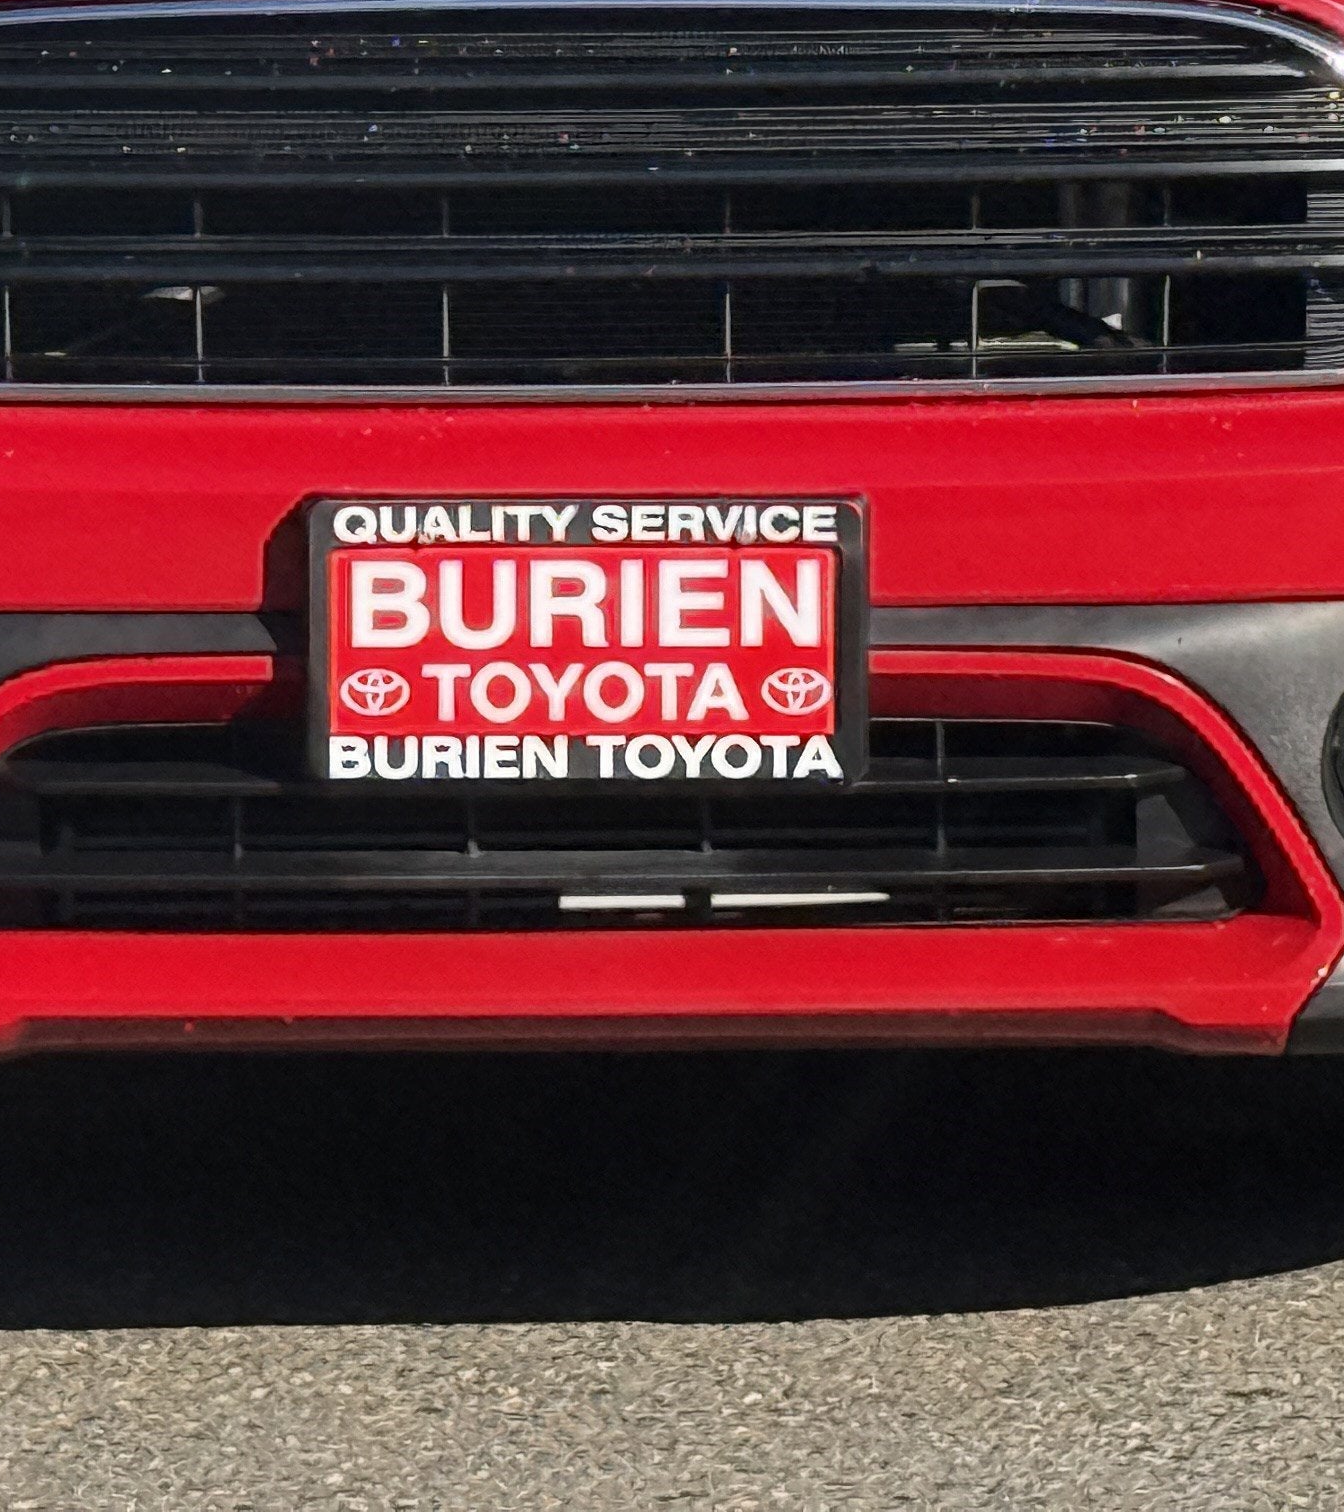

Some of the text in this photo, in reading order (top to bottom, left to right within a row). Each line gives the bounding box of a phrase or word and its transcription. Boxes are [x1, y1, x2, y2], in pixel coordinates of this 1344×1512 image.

[334, 505, 837, 543] QUALITY SERVICE
[352, 560, 820, 649] BURIEN
[422, 662, 747, 722] TOYOTA
[329, 735, 842, 779] BURIEN TOYOTA
